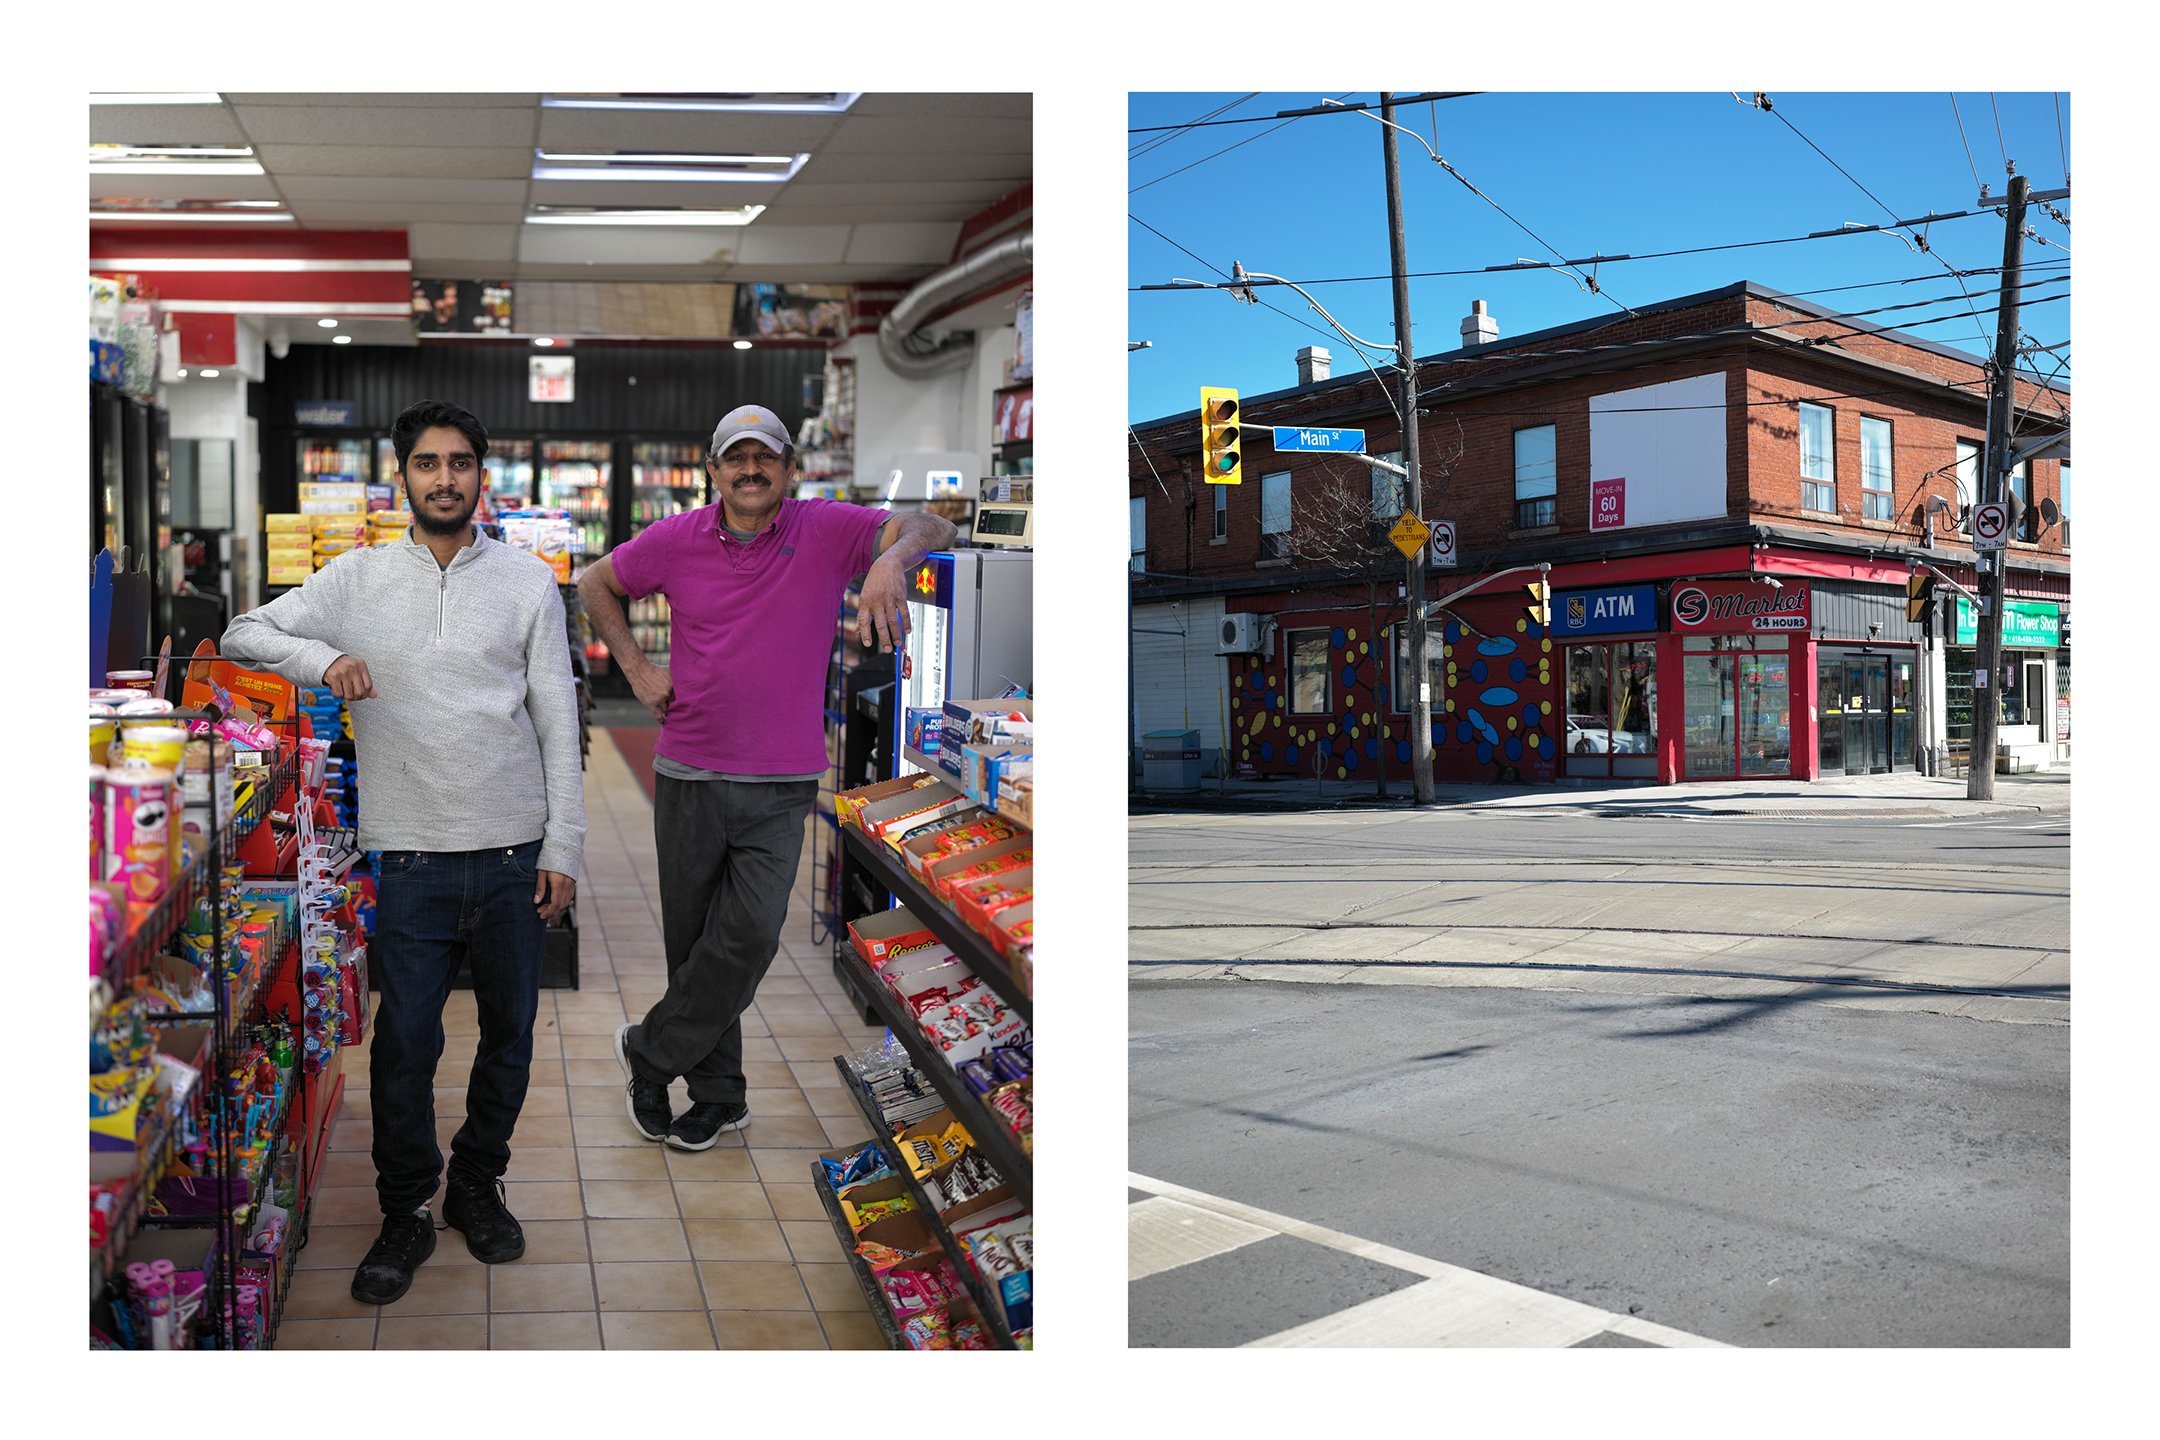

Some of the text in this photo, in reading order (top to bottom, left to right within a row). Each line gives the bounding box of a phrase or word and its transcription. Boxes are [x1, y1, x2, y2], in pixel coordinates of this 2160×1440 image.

[295, 407, 348, 425] water
[1300, 431, 1340, 446] Main St
[1595, 485, 1623, 495] MOVE-IN
[1601, 495, 1617, 512] 60
[1598, 513, 1619, 524] Days
[1393, 533, 1426, 541] PEDESTRIANS
[1593, 594, 1635, 618] ATM
[1711, 588, 1807, 619] Market
[1570, 618, 1584, 626] RBC
[1755, 617, 1806, 628] 24 HOURS
[2016, 615, 2039, 631] Flower
[2040, 614, 2059, 635] Shop
[1725, 640, 1741, 648] 165
[988, 1019, 1021, 1042] Kinder
